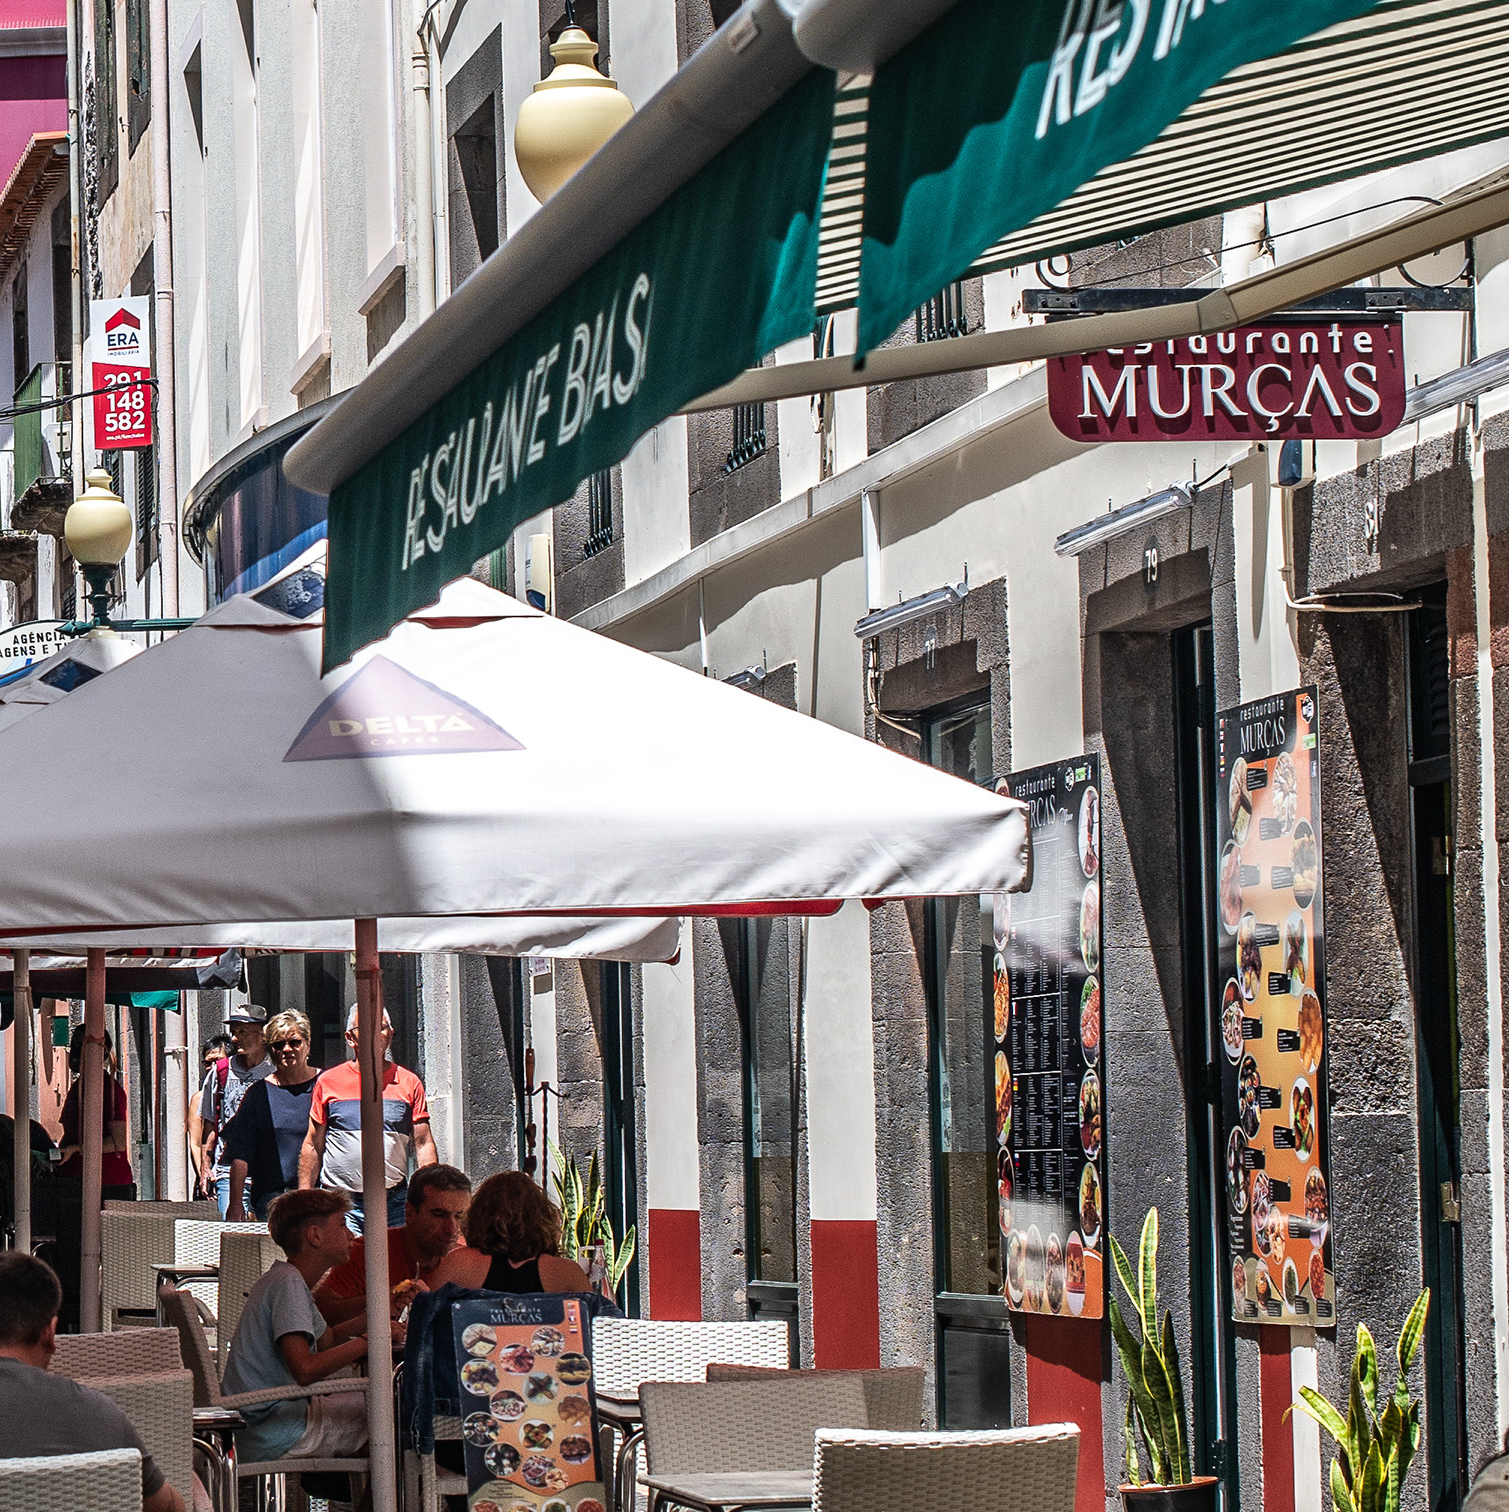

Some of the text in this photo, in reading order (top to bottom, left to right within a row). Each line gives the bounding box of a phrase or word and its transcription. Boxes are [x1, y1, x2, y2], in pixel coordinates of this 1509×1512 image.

[107, 332, 139, 347] ERA
[1081, 323, 1374, 355] saurante
[103, 371, 142, 393] 291
[106, 391, 145, 412] 148
[1077, 361, 1381, 433] MURÇAS
[105, 410, 146, 432] 582
[1144, 548, 1158, 583] 79
[42, 644, 49, 655] E
[1240, 716, 1286, 757] MURÇAS
